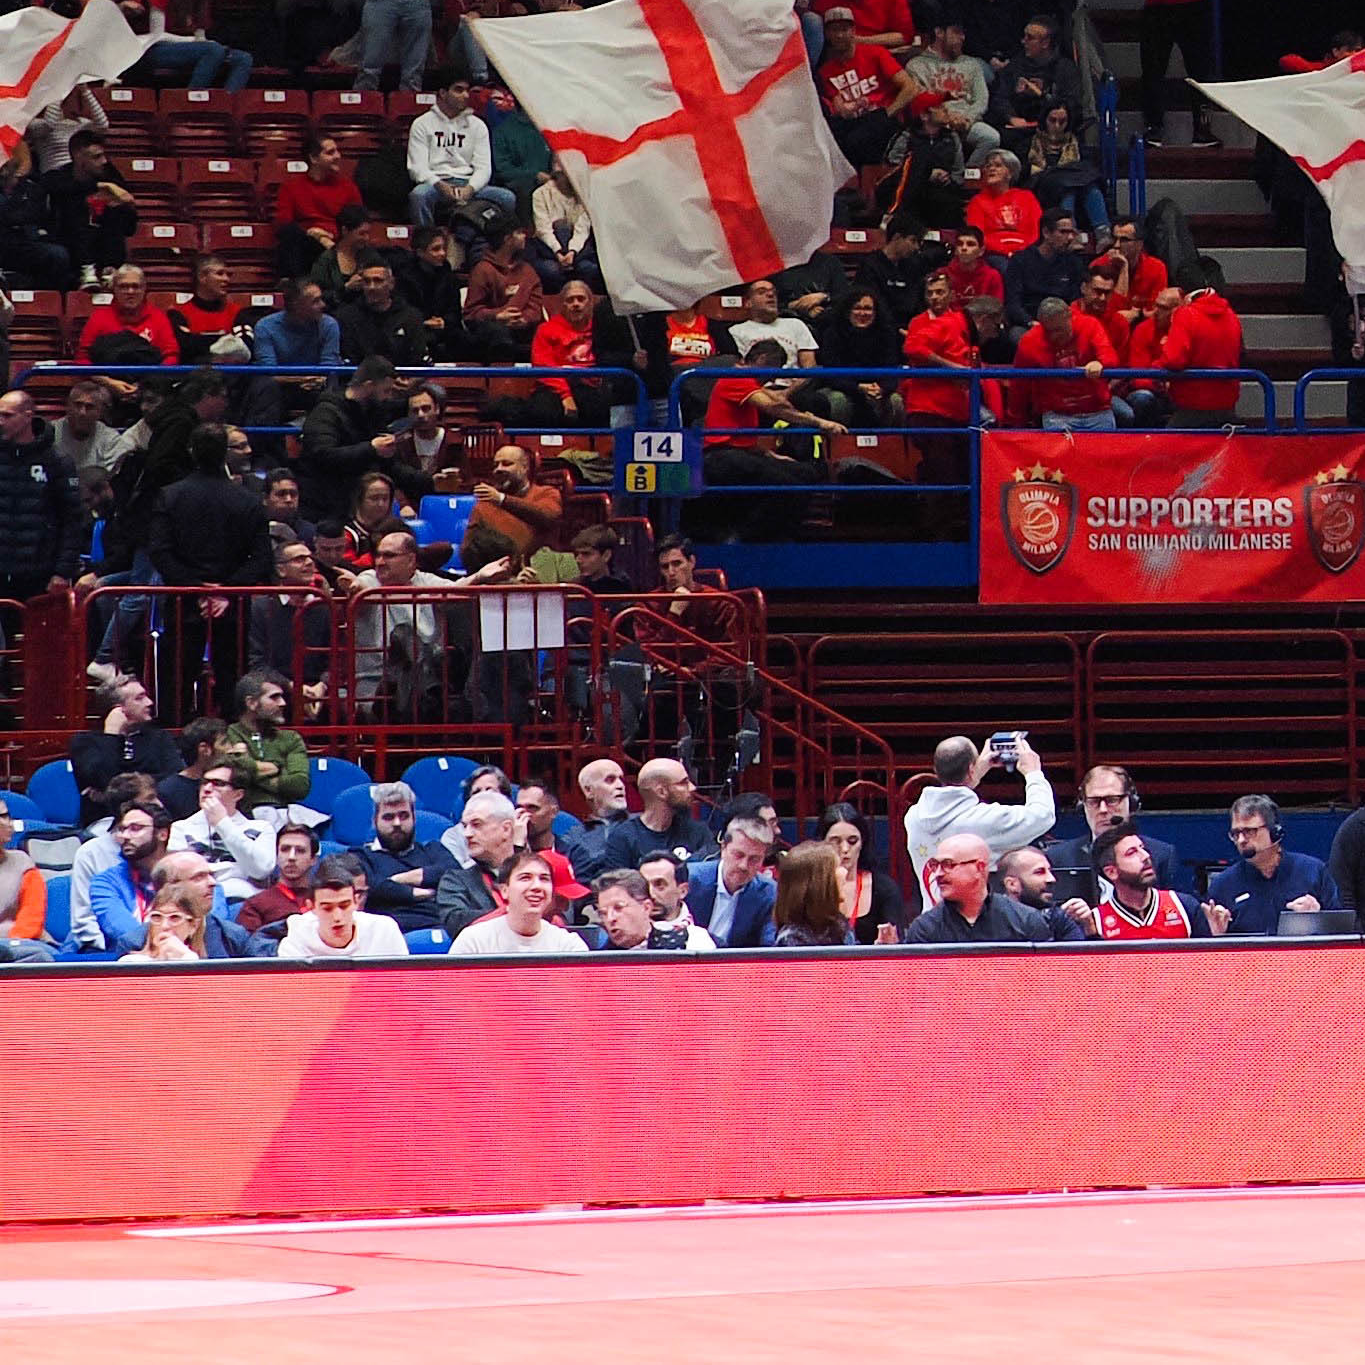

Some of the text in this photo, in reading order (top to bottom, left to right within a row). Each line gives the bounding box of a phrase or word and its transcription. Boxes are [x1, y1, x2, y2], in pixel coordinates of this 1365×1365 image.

[641, 436, 673, 457] 14
[634, 476, 647, 490] B
[1019, 490, 1060, 505] OLIMPIA
[1087, 497, 1293, 528] SUPPORTERS
[1022, 539, 1057, 555] MILANO
[1088, 532, 1293, 551] SAN GIULIANO MILANESE
